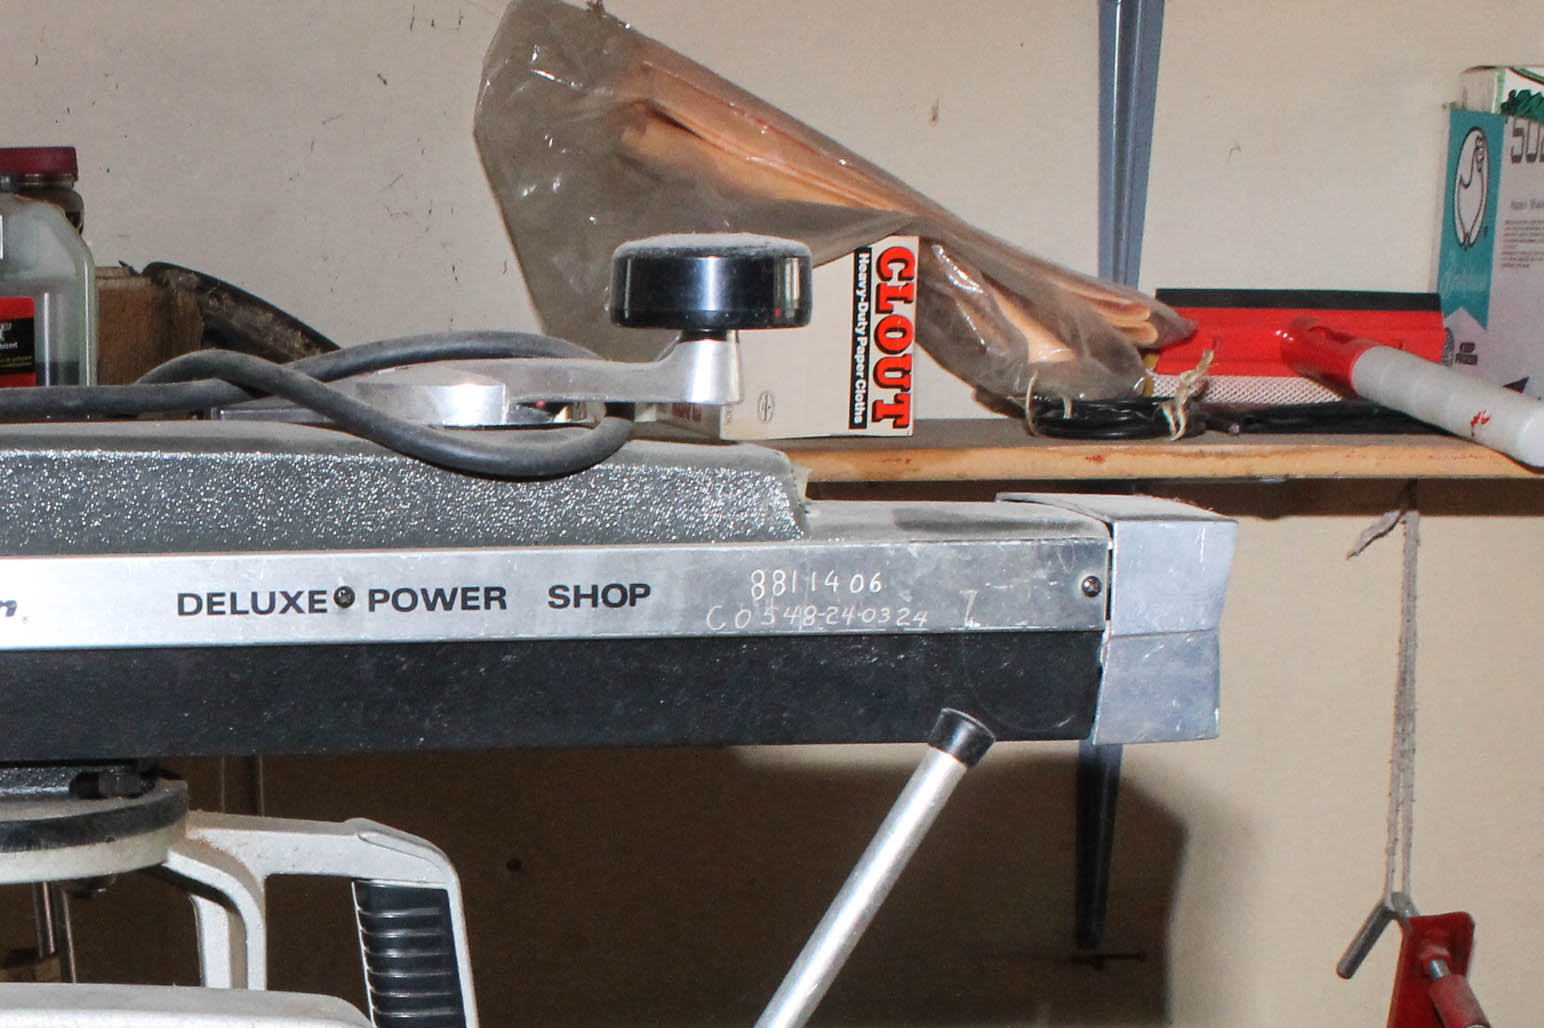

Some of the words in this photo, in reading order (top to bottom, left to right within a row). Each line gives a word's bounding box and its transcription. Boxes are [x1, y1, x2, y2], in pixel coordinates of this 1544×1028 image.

[856, 252, 871, 336] Heavy-Duty
[854, 336, 868, 378] Paper
[871, 246, 916, 430] CLOUT
[854, 381, 867, 424] Cloths
[176, 589, 328, 617] DELUXE
[367, 586, 508, 613] POWER
[547, 583, 652, 610] SHOP
